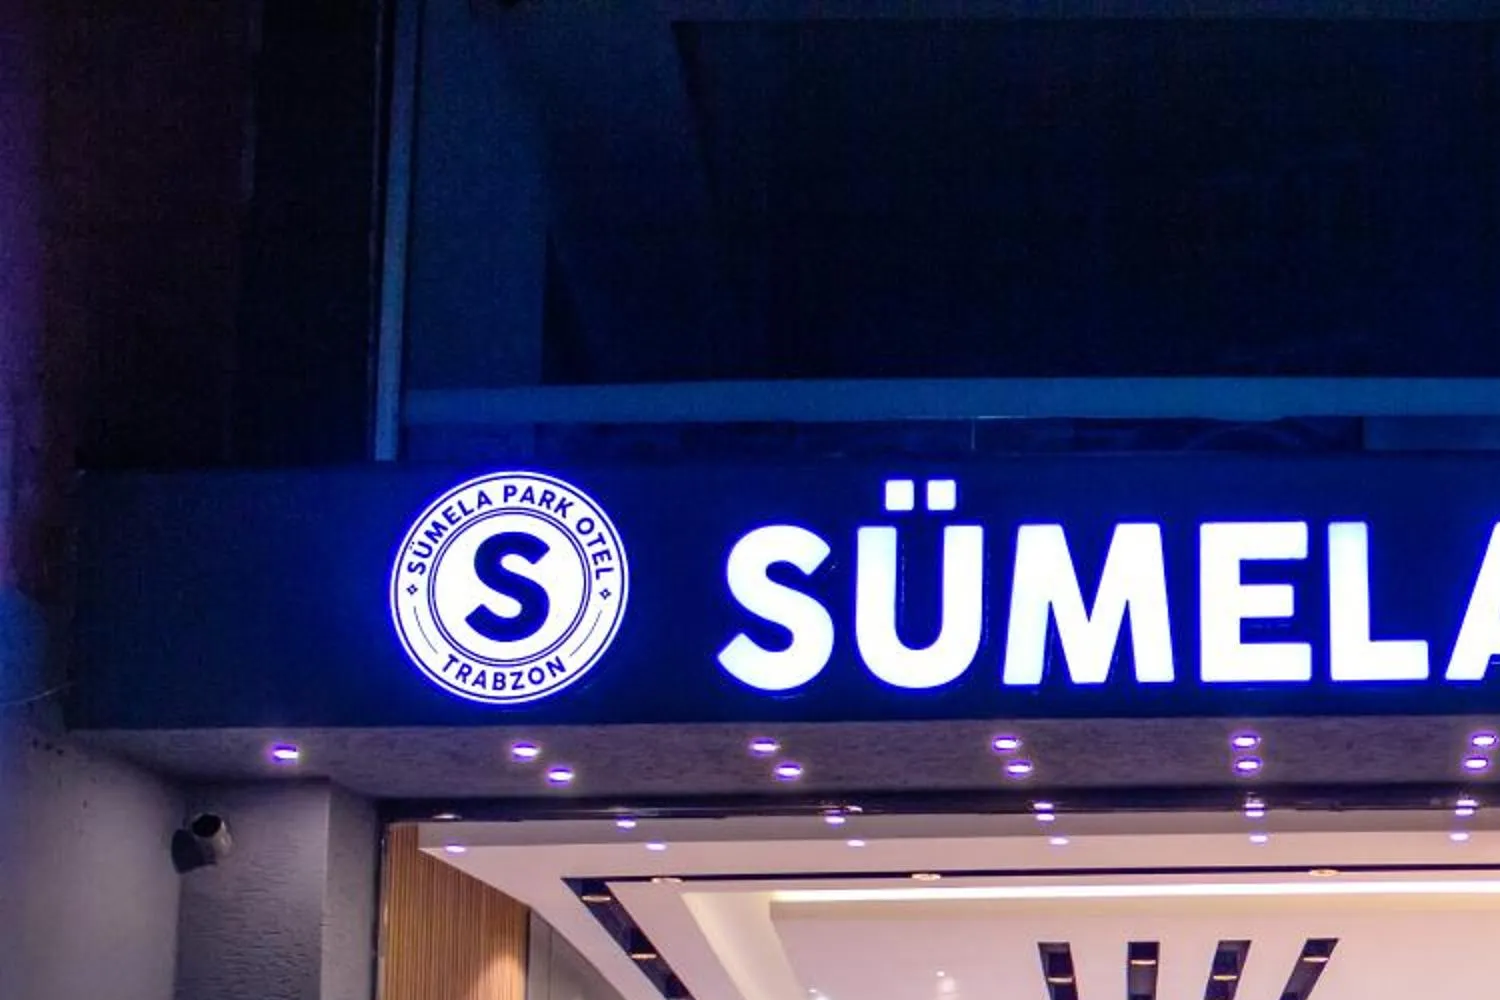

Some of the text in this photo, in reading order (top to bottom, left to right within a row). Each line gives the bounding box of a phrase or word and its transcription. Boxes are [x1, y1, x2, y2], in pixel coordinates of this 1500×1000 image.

[407, 484, 615, 580] SÜMELA PARK OTEL
[464, 530, 551, 642] S
[441, 653, 567, 691] TRABZON
